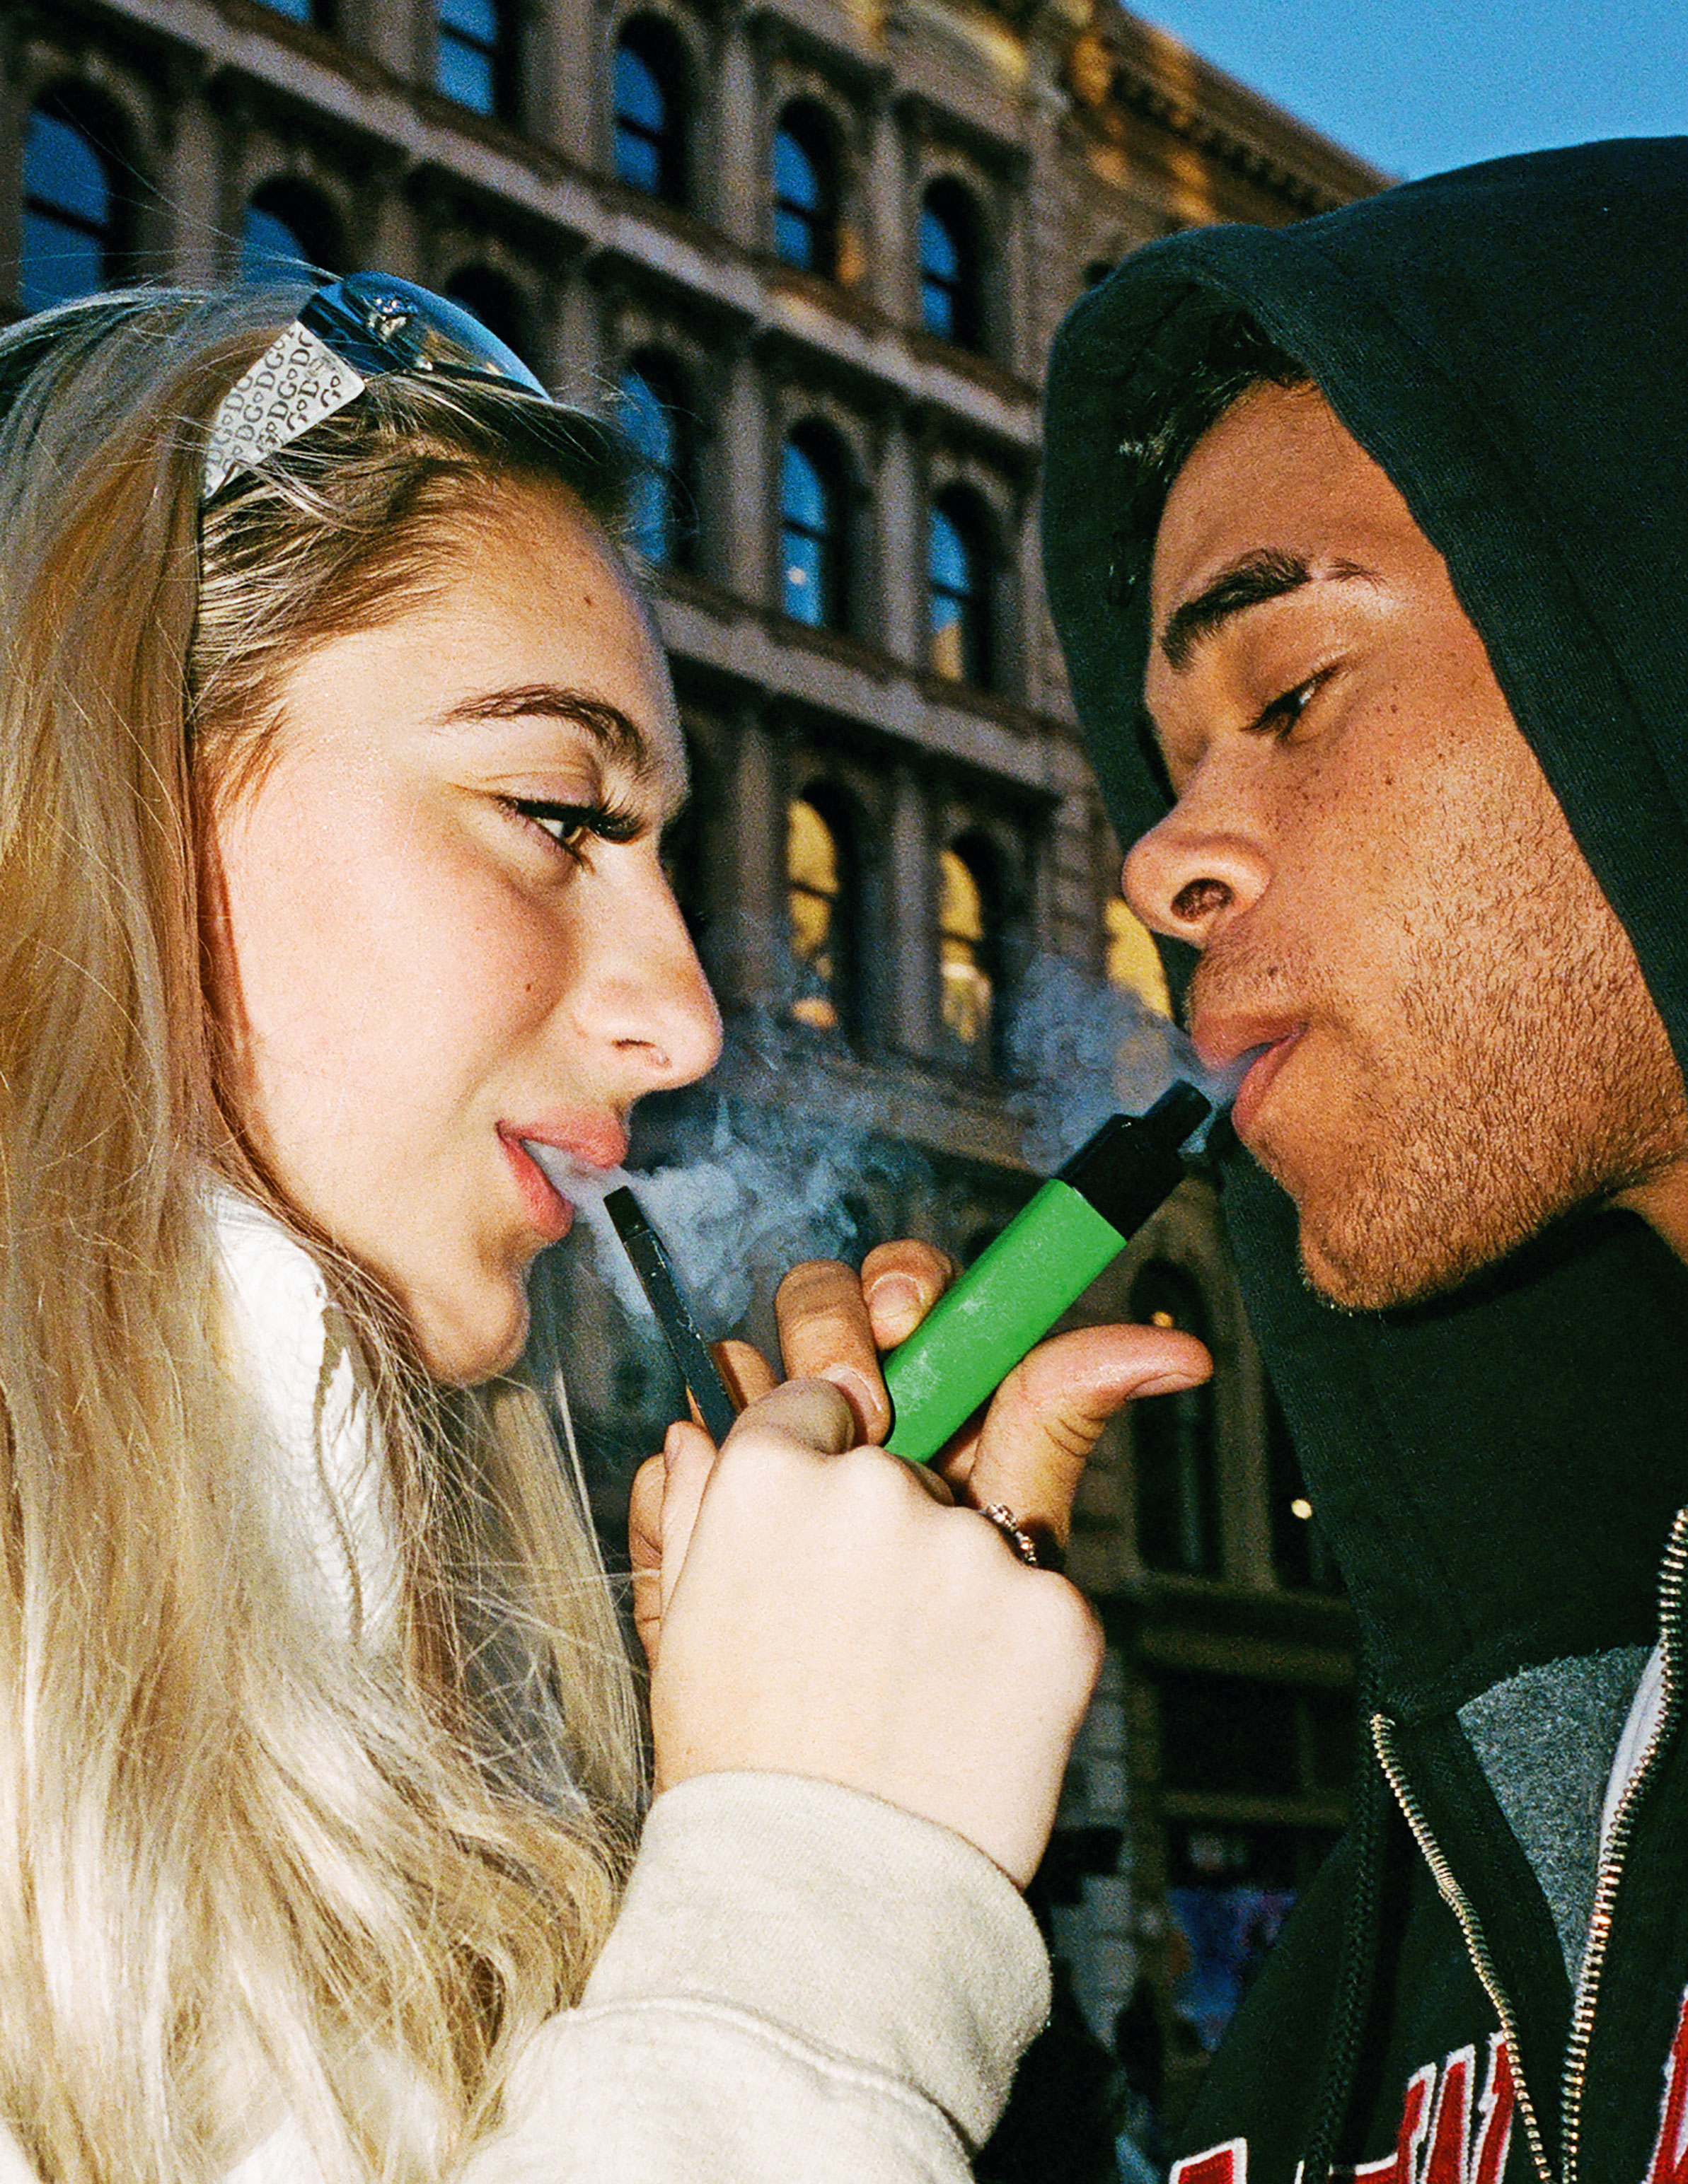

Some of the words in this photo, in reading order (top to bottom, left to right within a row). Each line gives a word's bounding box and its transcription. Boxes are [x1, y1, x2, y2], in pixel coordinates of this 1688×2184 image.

[234, 404, 263, 441] DG
[254, 352, 284, 390] DG
[267, 381, 297, 419] DG
